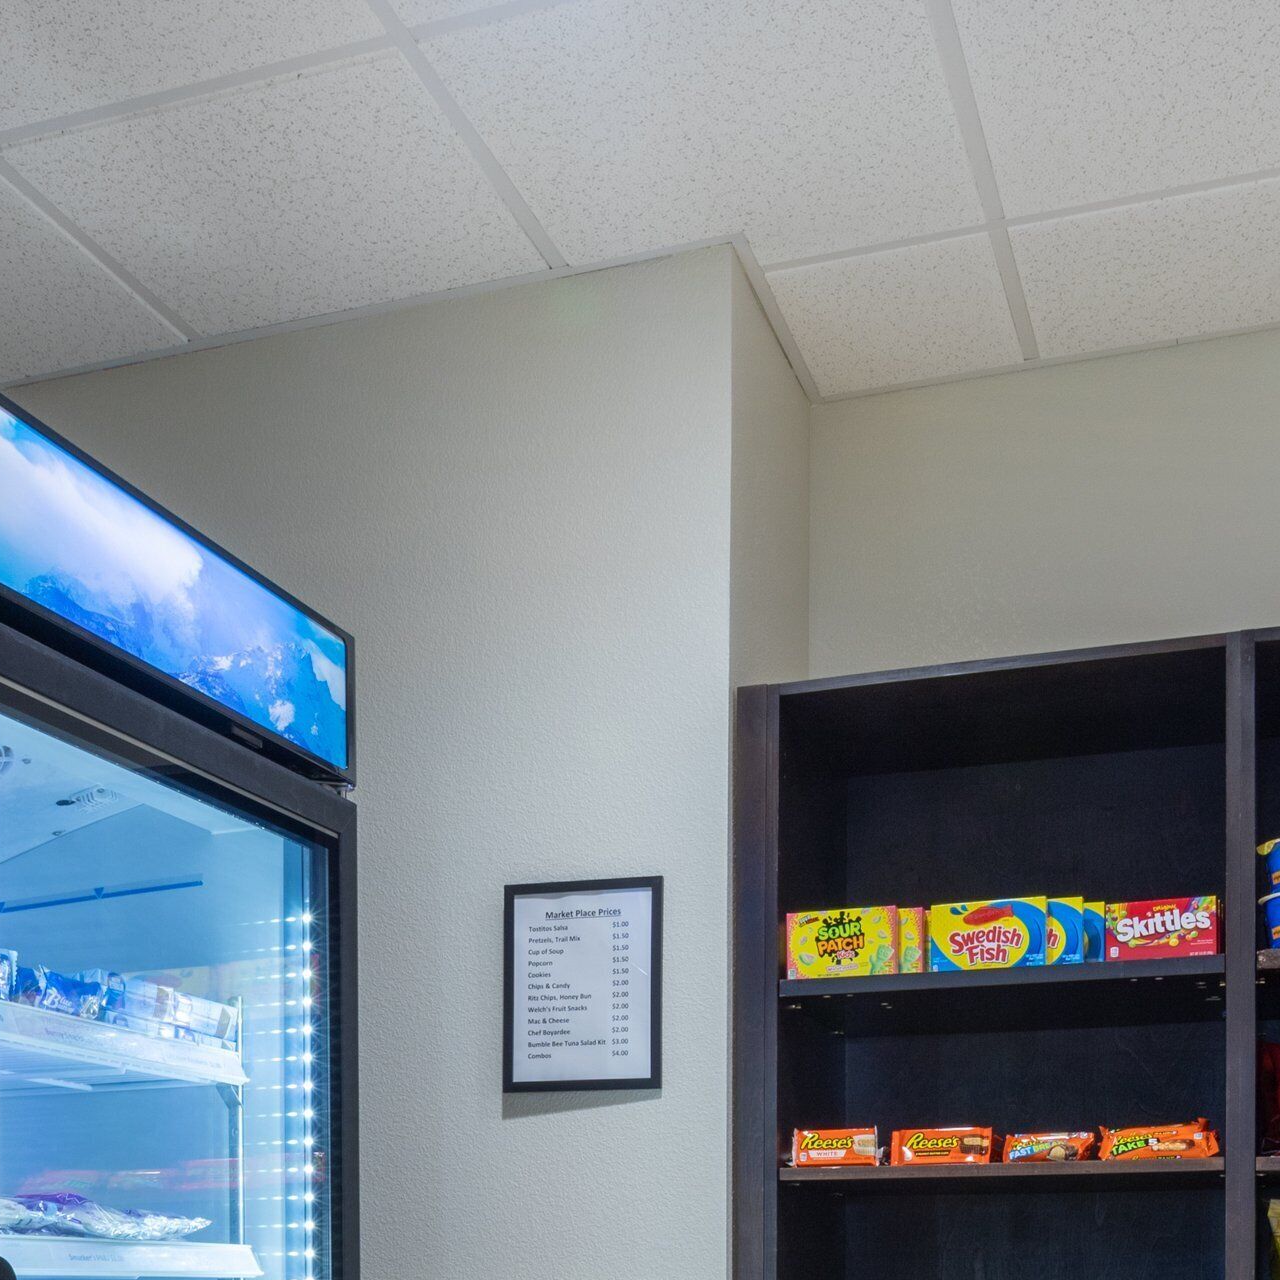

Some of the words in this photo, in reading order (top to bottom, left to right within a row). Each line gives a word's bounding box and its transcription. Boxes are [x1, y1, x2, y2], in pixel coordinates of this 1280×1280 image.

[545, 911, 573, 919] Market
[575, 909, 596, 918] Place
[598, 908, 621, 916] Prices
[817, 922, 862, 941] SOUR
[1116, 908, 1212, 942] Skittles
[815, 933, 865, 958] PATCH
[948, 925, 1024, 954] Swedish
[965, 946, 1009, 965] Fish
[800, 1132, 853, 1150] Reese's
[905, 1132, 959, 1150] Reese's
[1111, 1140, 1147, 1156] TAKE
